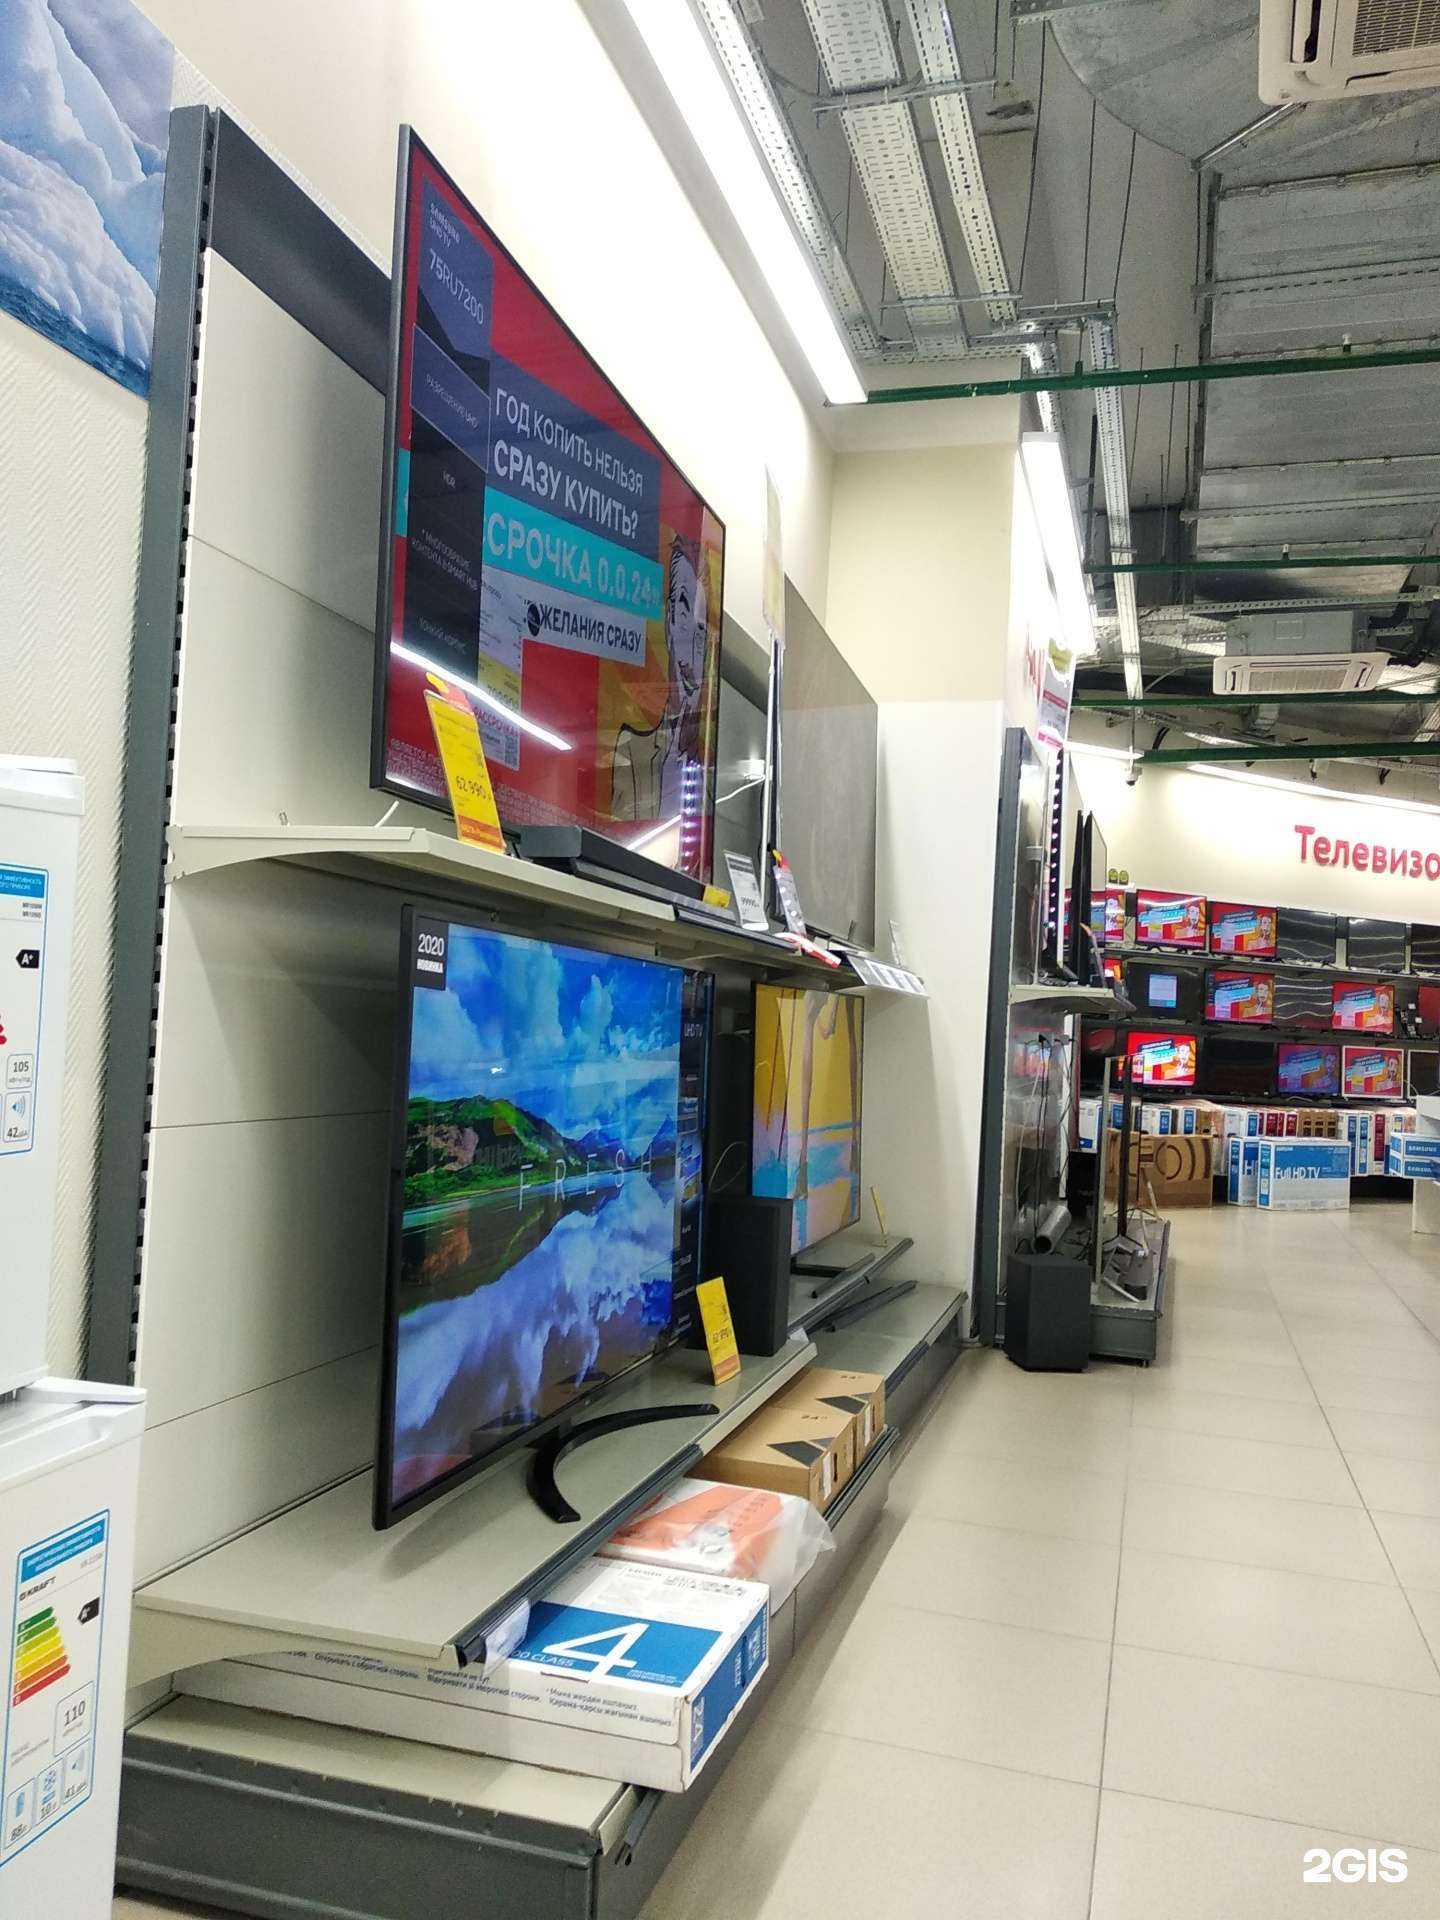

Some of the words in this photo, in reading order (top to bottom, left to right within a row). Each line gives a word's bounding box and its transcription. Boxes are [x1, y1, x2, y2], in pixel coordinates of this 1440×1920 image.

[429, 247, 484, 325] 75RU7200
[496, 387, 531, 439] ГОД
[533, 409, 593, 468] КОПИТЬ
[594, 447, 644, 497] НЕЛЬЗЯ
[494, 438, 562, 501] СРАЗУ
[564, 474, 639, 540] КУПИТЬ?
[538, 604, 606, 646] ЖЕЛАНИЯ
[606, 624, 642, 654] СРАЗУ
[1294, 824, 1440, 881] Телевизо
[418, 933, 445, 957] 2020
[13, 1061, 29, 1073] 105
[7, 1127, 18, 1138] 42
[1292, 1166, 1307, 1180] HD
[1307, 1166, 1321, 1180] TV
[530, 1652, 576, 1669] CLASS
[542, 1622, 650, 1682] 4
[64, 1700, 86, 1727] 110
